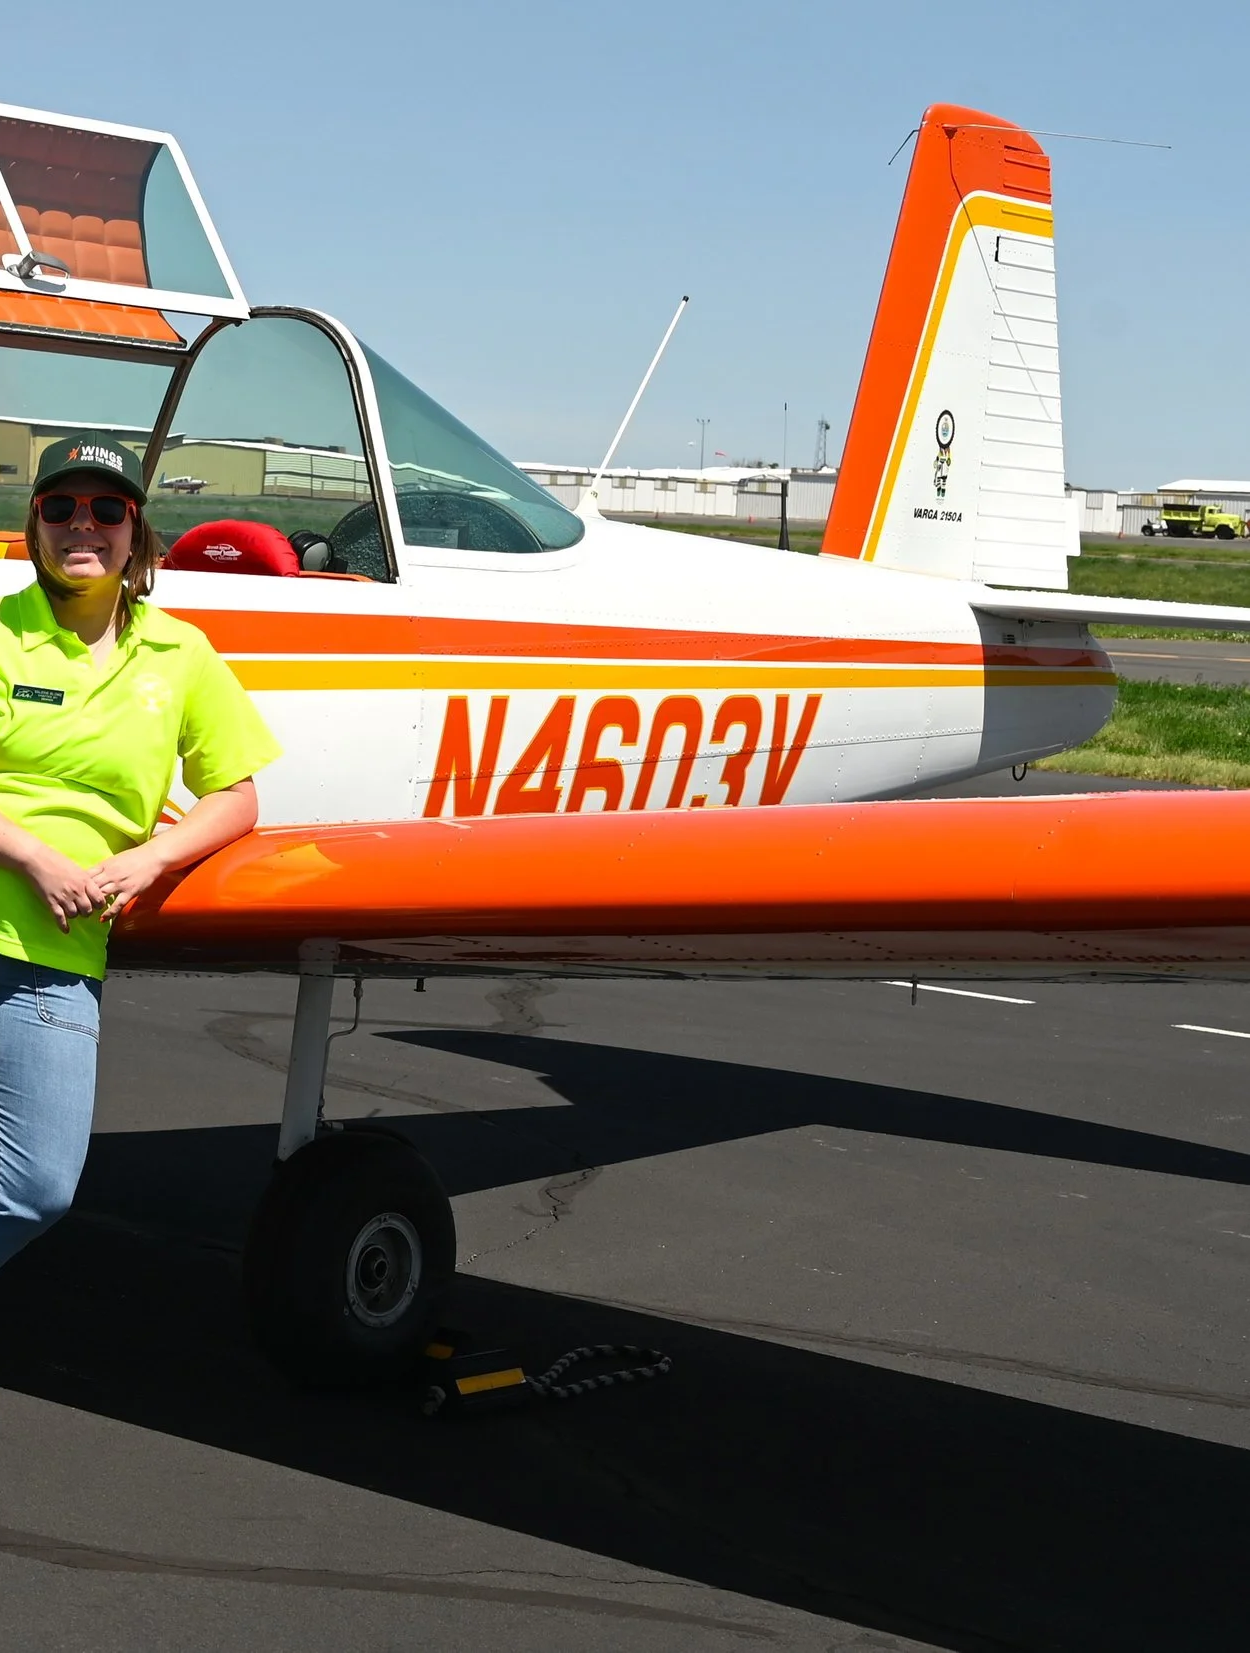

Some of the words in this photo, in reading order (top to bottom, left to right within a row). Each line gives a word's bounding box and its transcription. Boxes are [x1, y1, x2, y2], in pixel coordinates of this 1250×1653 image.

[81, 445, 123, 467] WINGS
[913, 507, 938, 520] VARGA
[421, 693, 823, 818] N4603V
